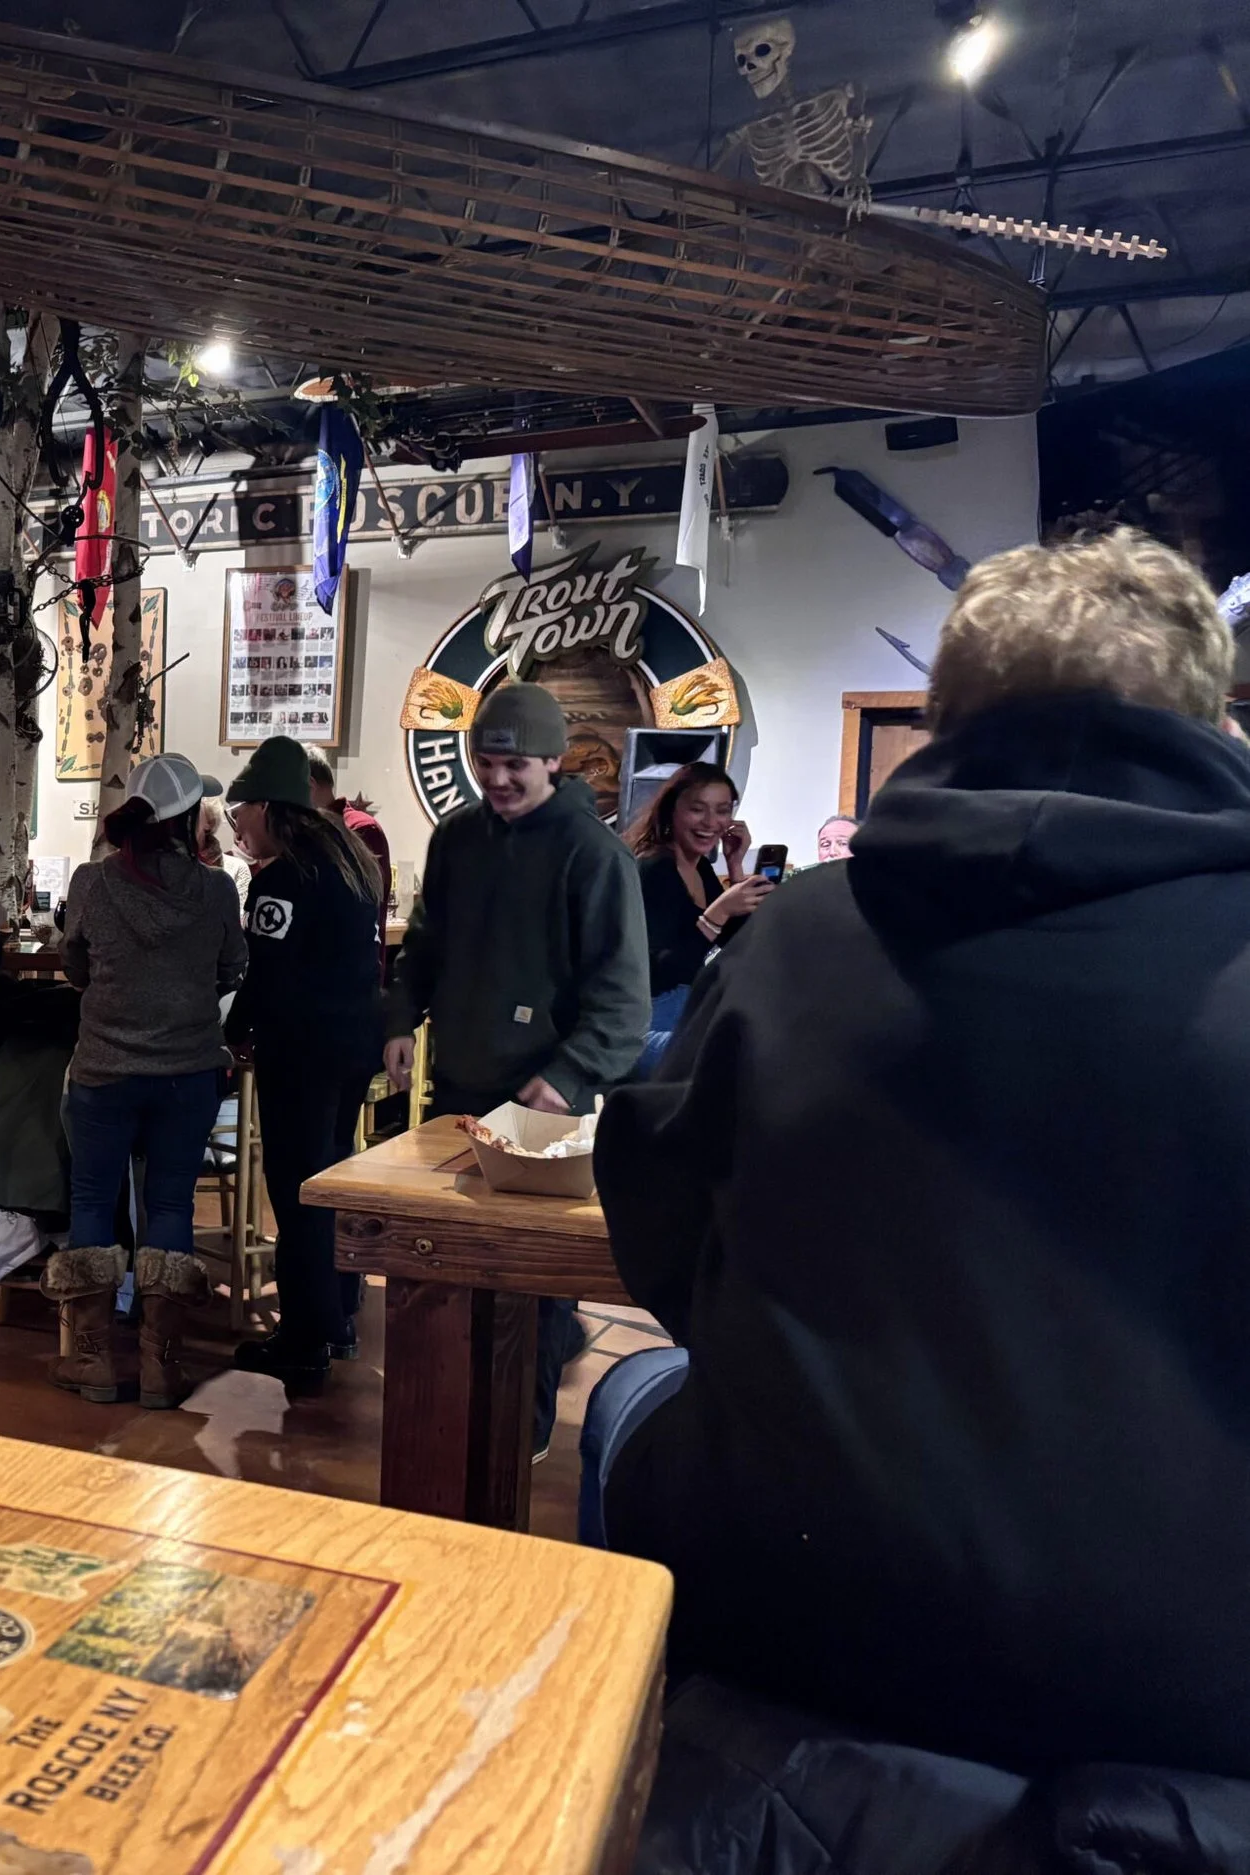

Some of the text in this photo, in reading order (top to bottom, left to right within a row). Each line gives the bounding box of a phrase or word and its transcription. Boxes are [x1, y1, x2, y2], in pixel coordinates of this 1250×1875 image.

[4, 1686, 149, 1815] ROSCOE NY
[6, 1715, 65, 1750] THE
[83, 1752, 153, 1803] BEER
